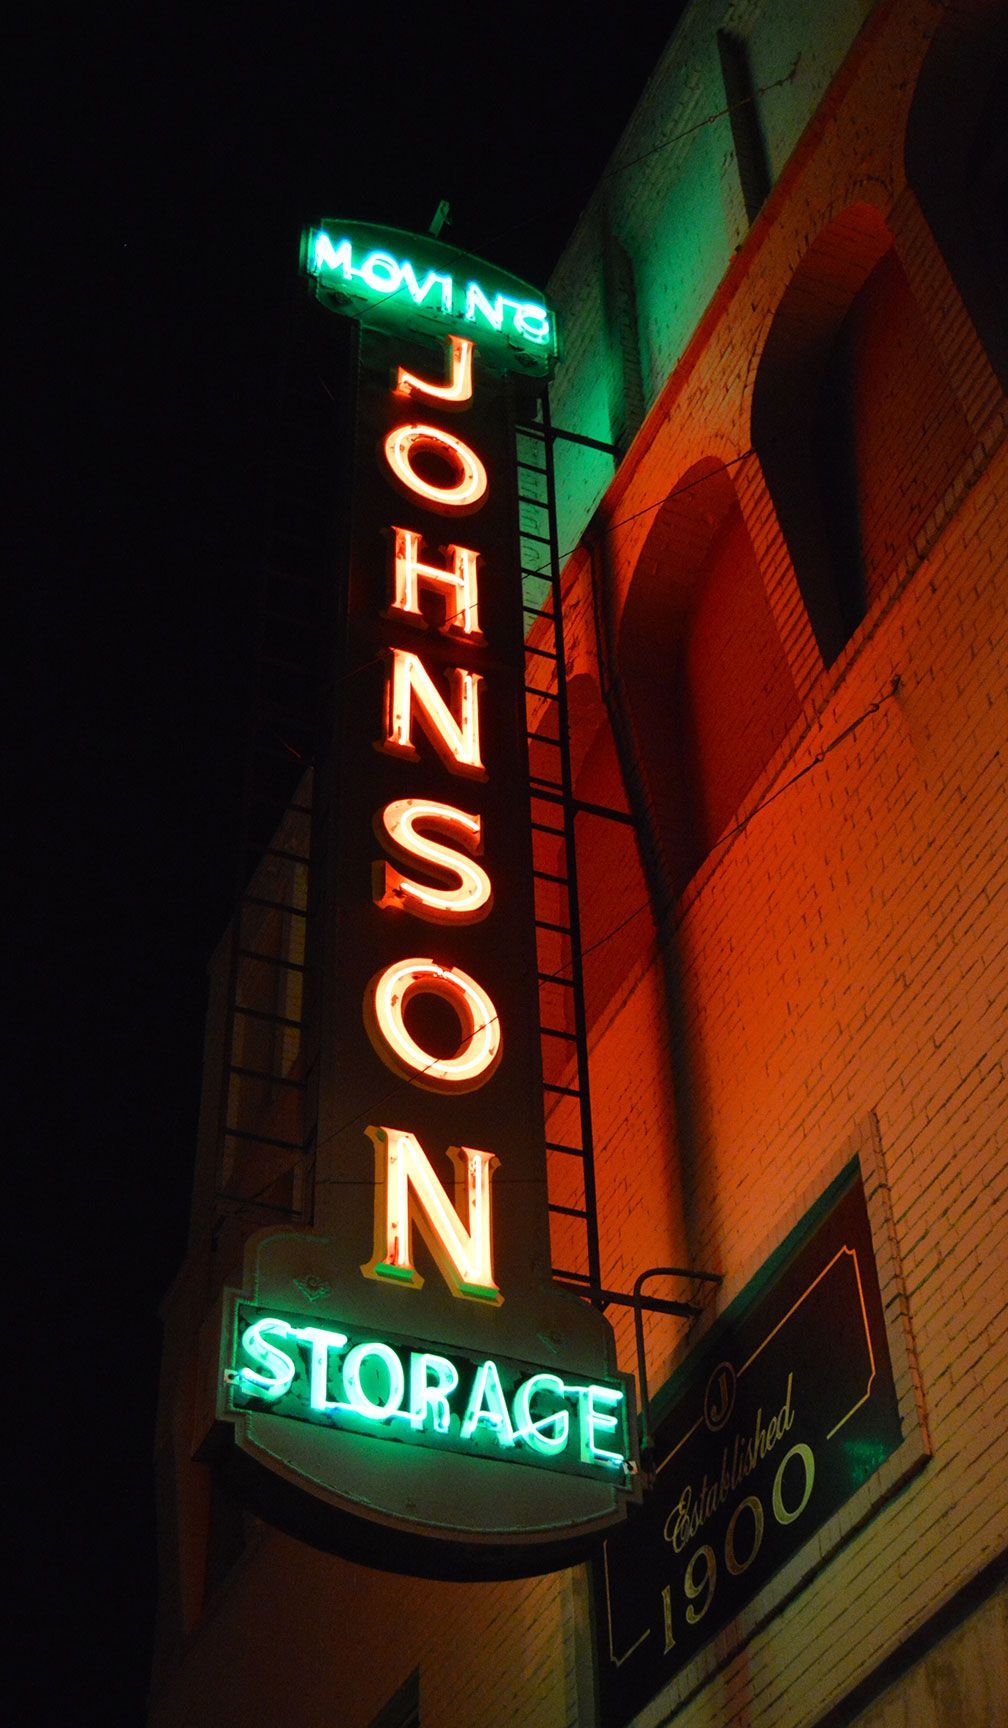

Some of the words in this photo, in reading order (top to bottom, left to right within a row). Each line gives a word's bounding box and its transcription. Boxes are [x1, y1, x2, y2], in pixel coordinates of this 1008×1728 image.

[313, 231, 551, 344] MOVING
[364, 334, 504, 1306] JOHNSON
[240, 1316, 626, 1468] STORAGE
[663, 1371, 795, 1553] Established
[661, 1443, 816, 1655] 1900
